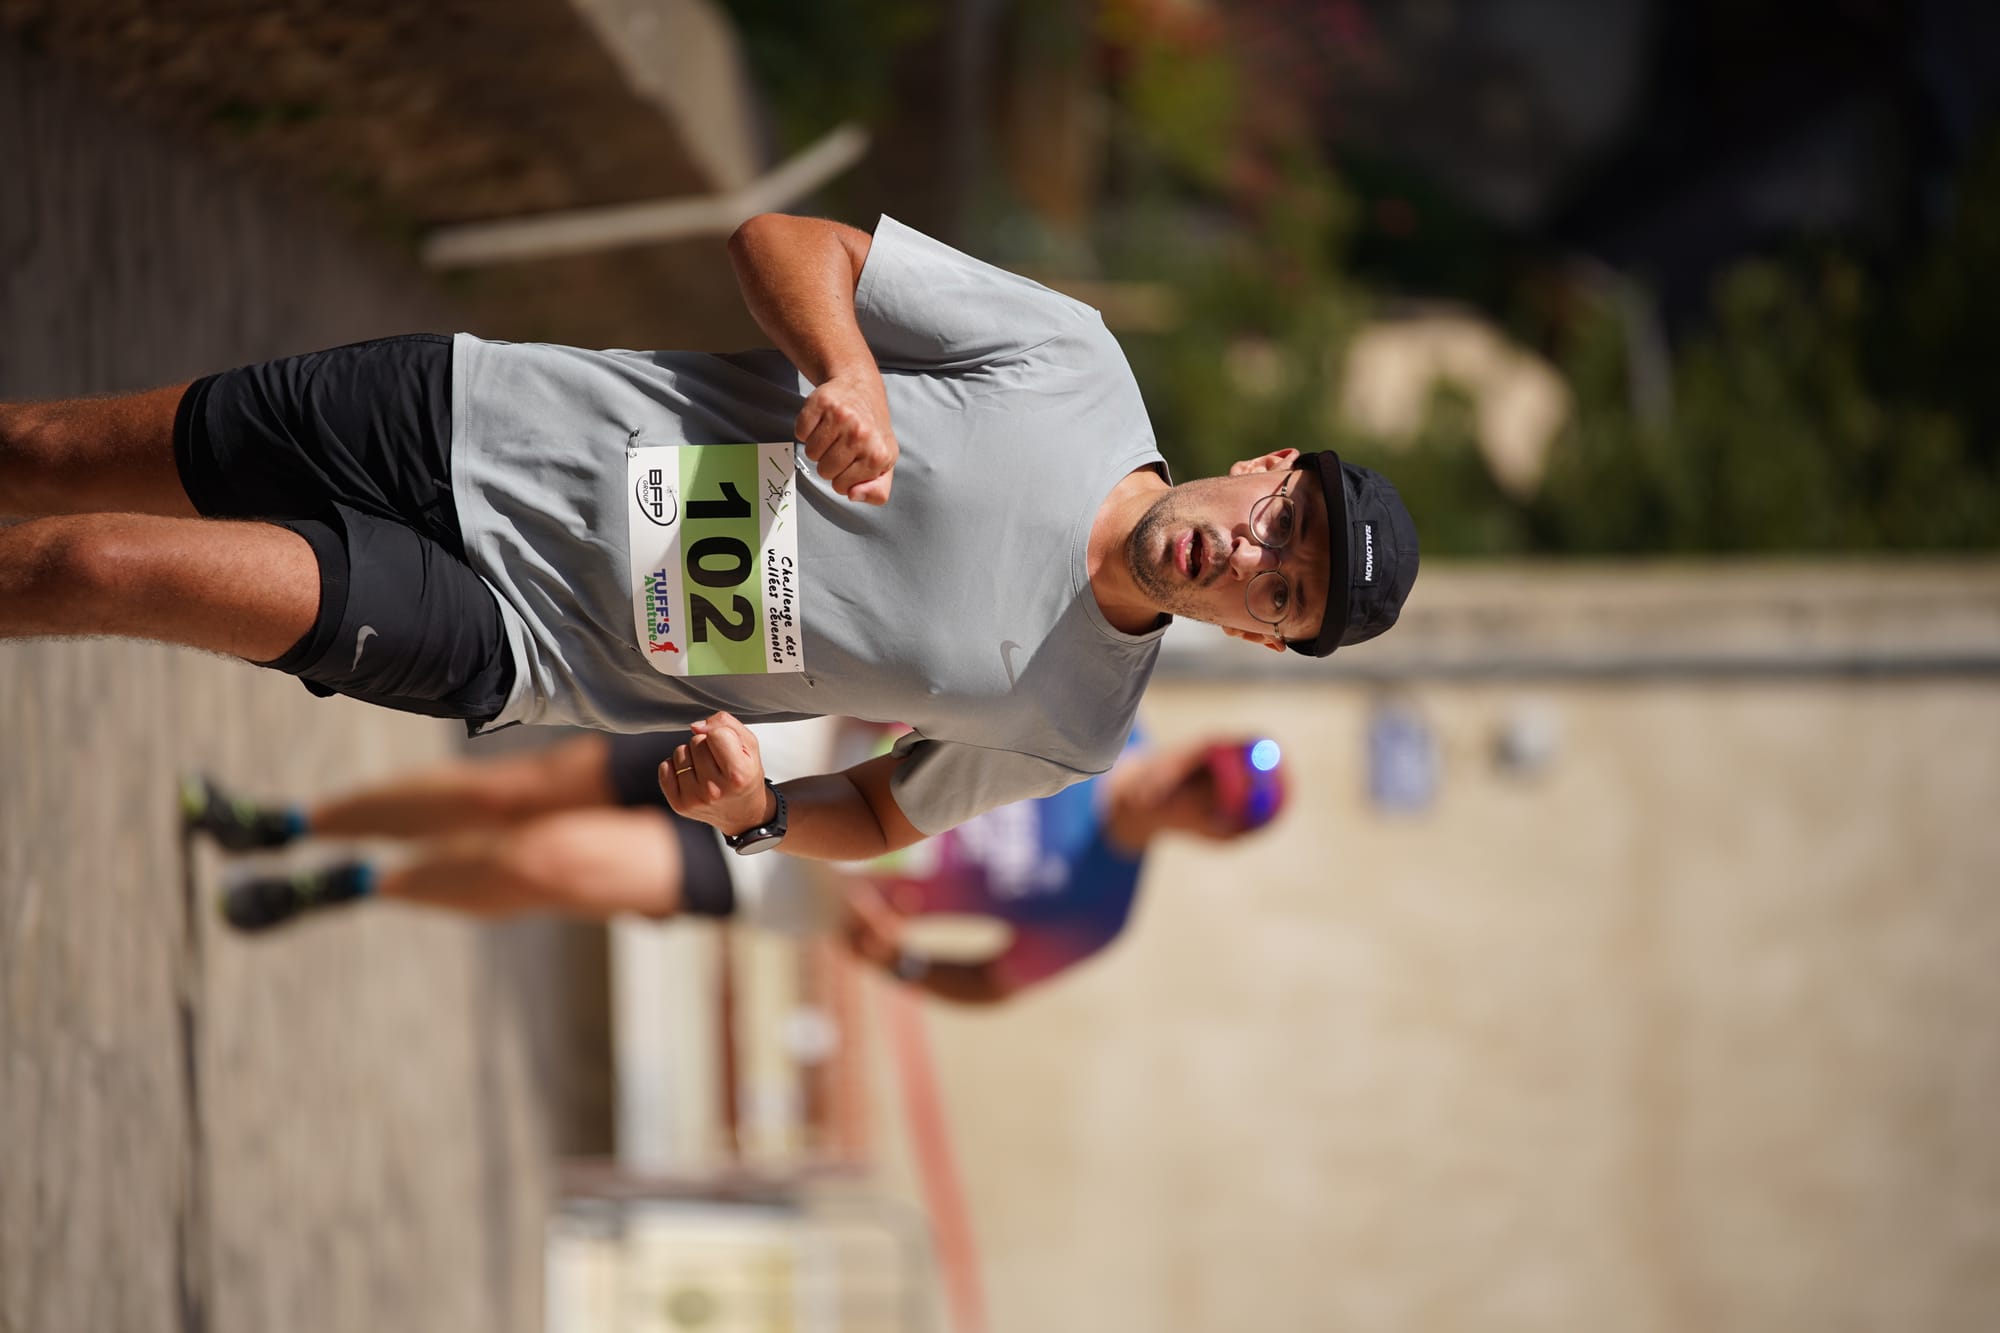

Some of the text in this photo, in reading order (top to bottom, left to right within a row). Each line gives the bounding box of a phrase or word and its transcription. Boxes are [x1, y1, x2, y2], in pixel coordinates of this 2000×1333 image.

[649, 469, 663, 518] BFP
[685, 481, 755, 643] 102
[1365, 524, 1373, 582] SALOMON
[644, 575, 658, 641] Aventure
[653, 568, 670, 635] TUFF'S
[768, 548, 783, 664] vallées cévenoles
[780, 556, 797, 657] Challenge des
